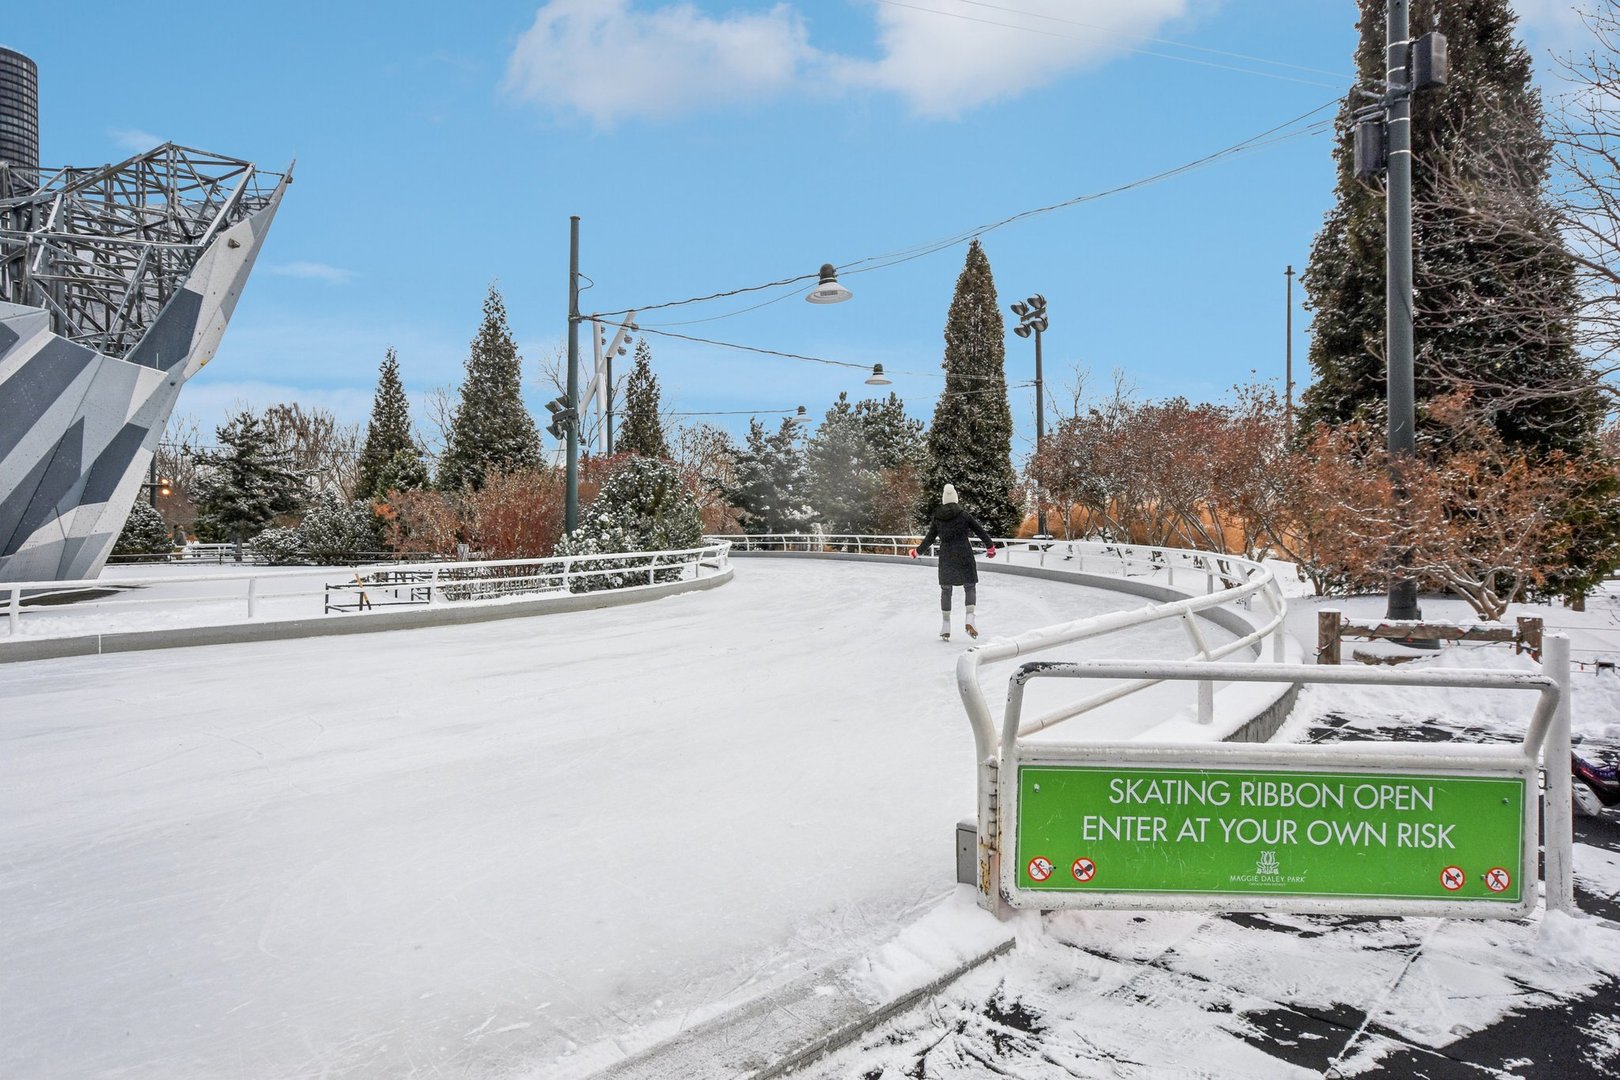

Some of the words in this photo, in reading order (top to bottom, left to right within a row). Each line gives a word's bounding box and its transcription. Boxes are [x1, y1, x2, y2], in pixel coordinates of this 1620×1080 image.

[1109, 778, 1231, 806] SKATING
[1241, 781, 1344, 808] RIBBON
[1353, 784, 1433, 811] OPEN
[1083, 815, 1168, 842] ENTER
[1176, 817, 1211, 842] AT
[1219, 818, 1298, 845] YOUR
[1307, 820, 1387, 847] OWN
[1397, 822, 1456, 849] RISK
